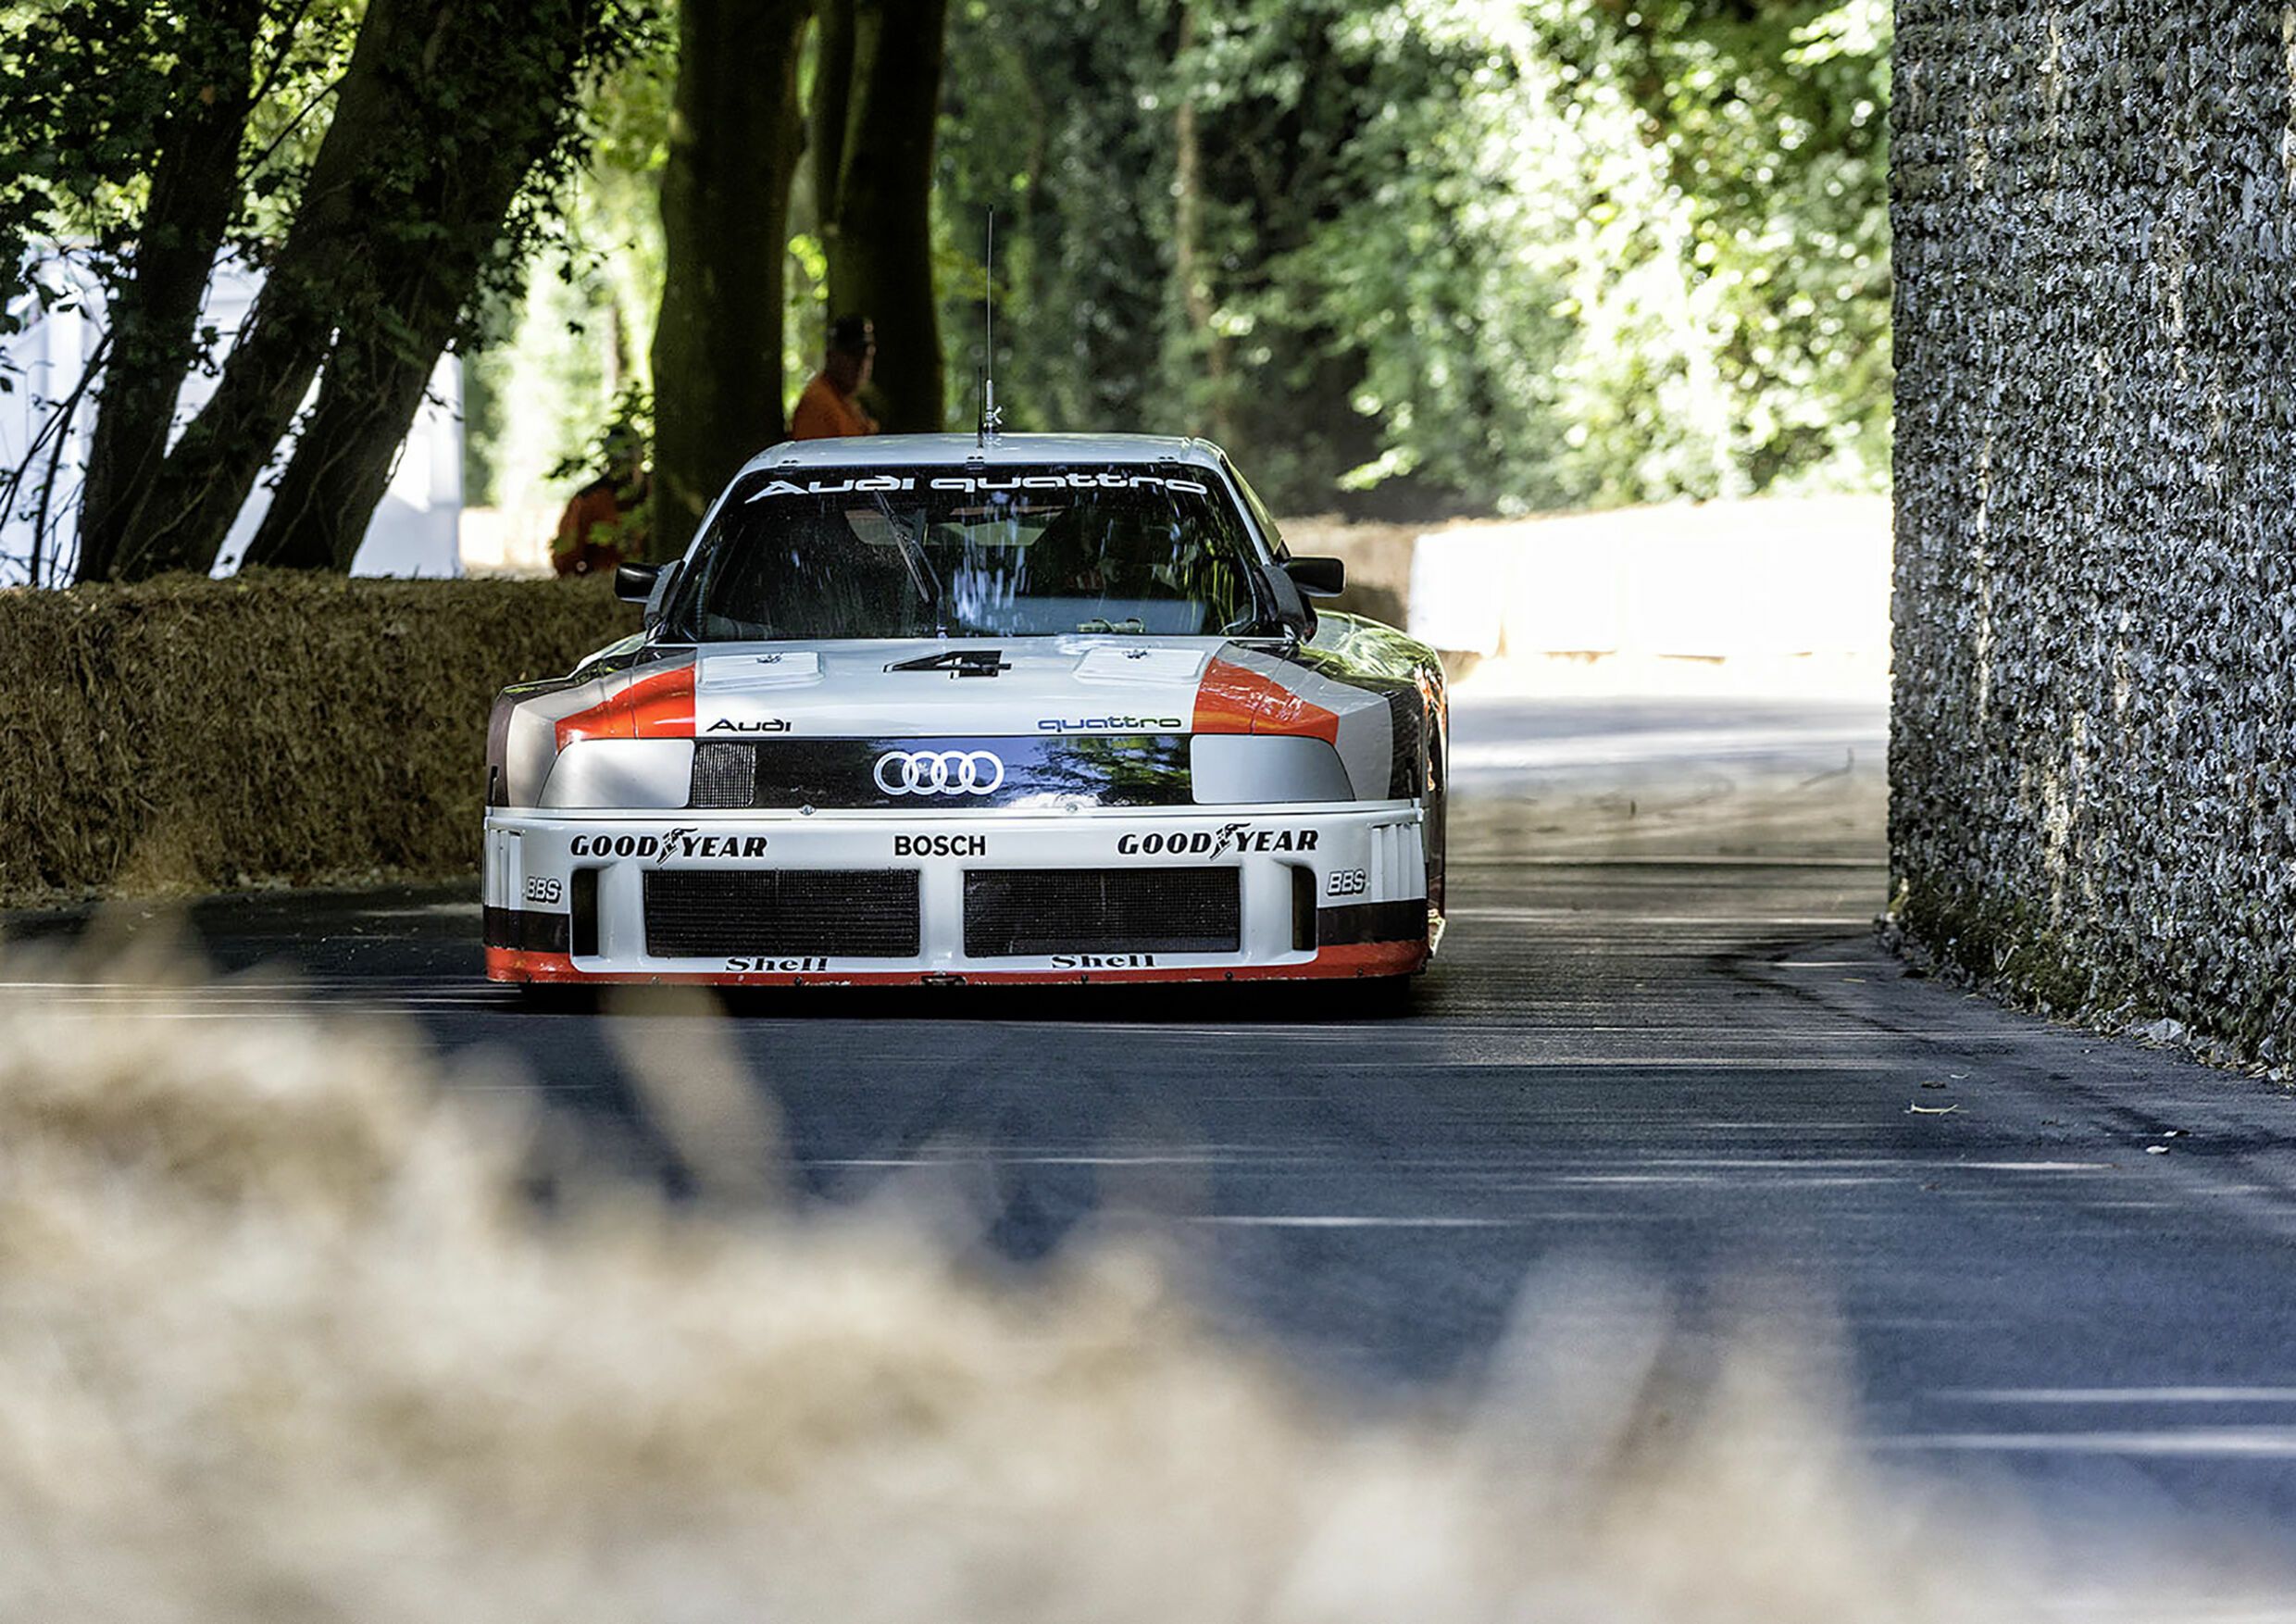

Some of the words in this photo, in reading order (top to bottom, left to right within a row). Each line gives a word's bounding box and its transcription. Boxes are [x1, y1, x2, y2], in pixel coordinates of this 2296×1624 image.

[744, 475, 915, 504] Audi
[930, 473, 1207, 495] quattro
[883, 650, 1012, 680] 4
[705, 718, 792, 734] Audi
[1038, 716, 1182, 734] quattro
[894, 835, 986, 857] BOSCH
[526, 876, 563, 904] BBS
[1326, 868, 1366, 896] BBS
[725, 956, 829, 974] Shell
[1051, 953, 1155, 971] Shell
